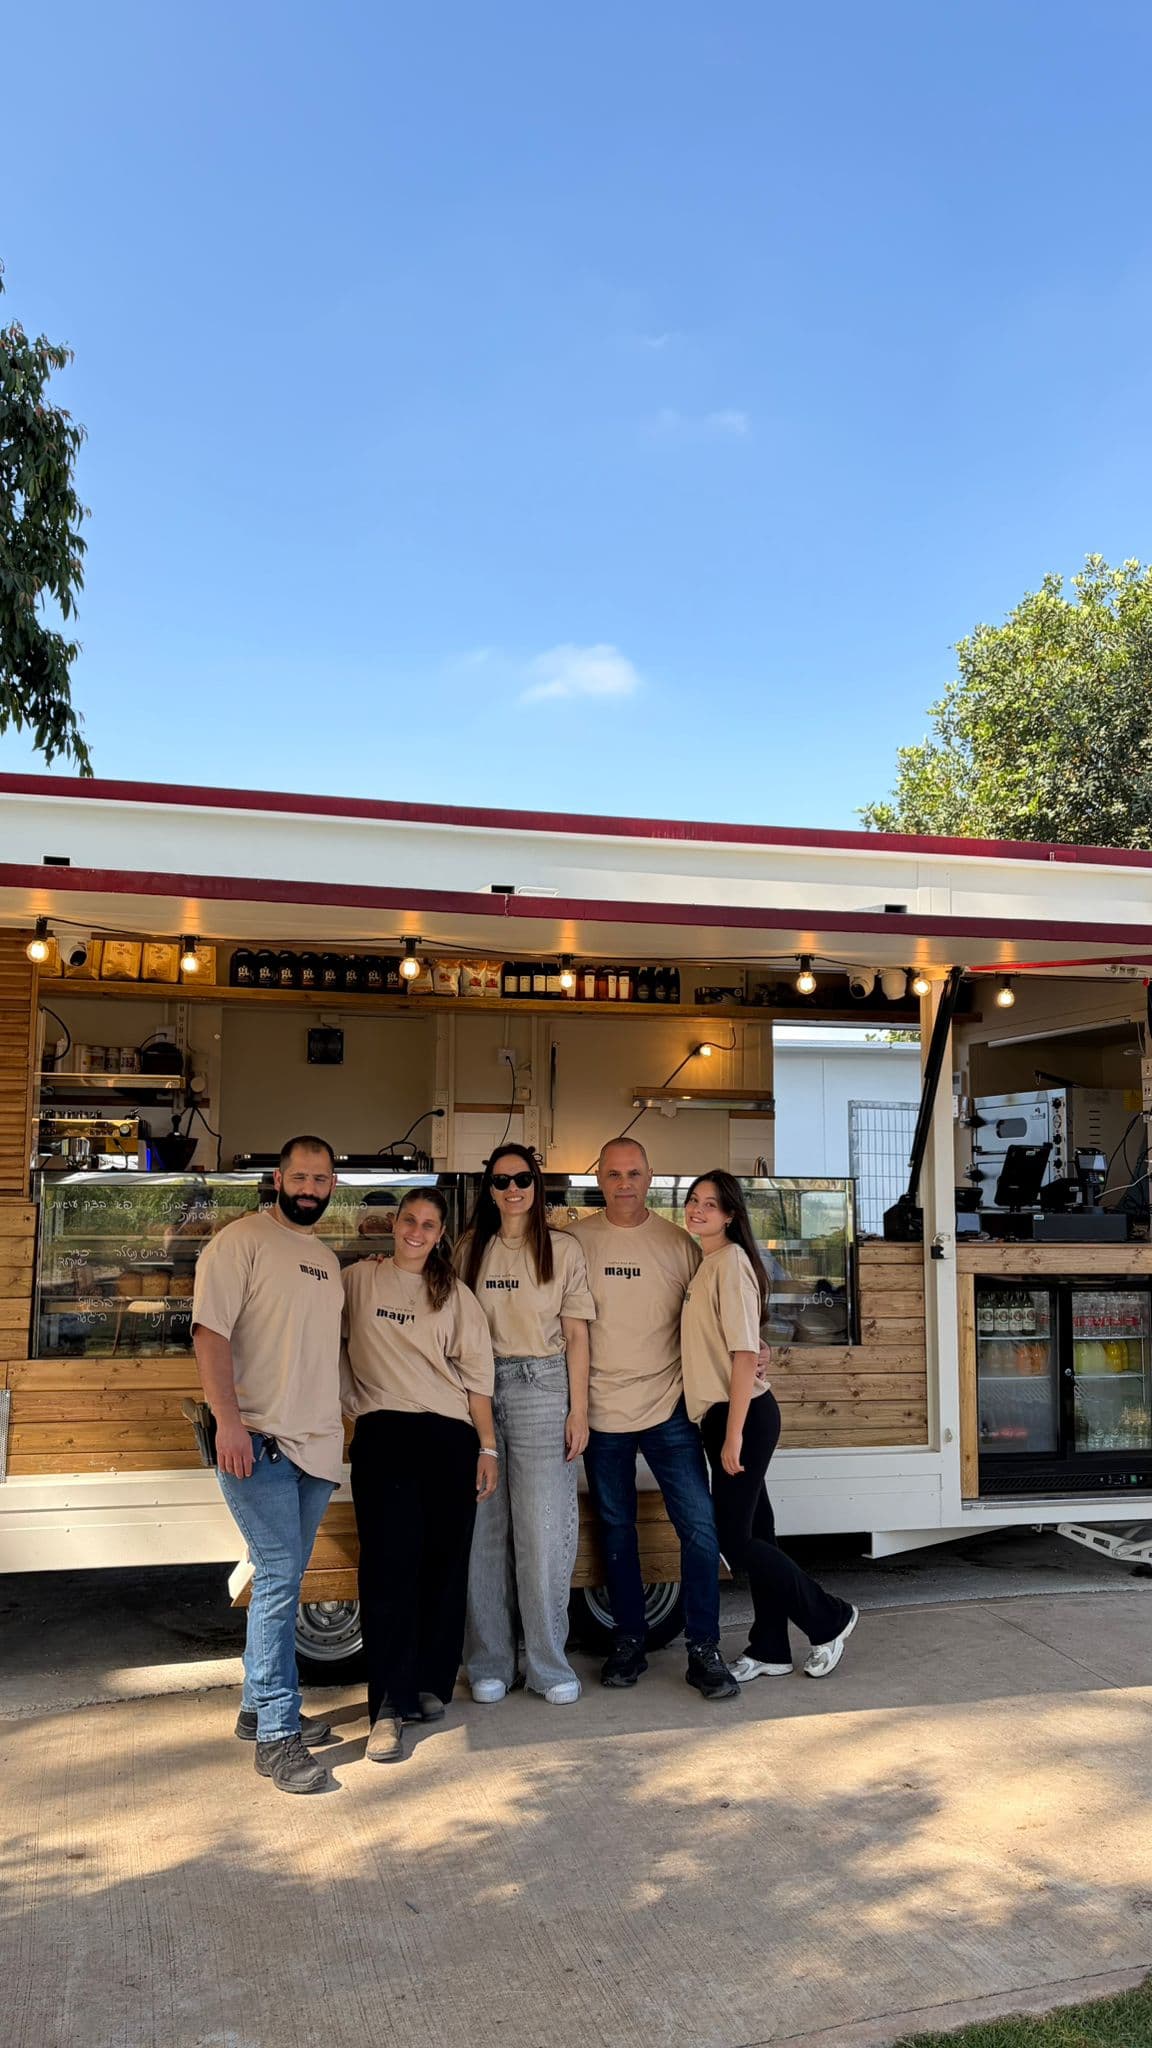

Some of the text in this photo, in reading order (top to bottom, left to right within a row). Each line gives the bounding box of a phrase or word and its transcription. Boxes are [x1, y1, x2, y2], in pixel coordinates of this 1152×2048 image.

[299, 1264, 328, 1280] mayu
[604, 1267, 641, 1279] mayu
[486, 1280, 519, 1291] mayu
